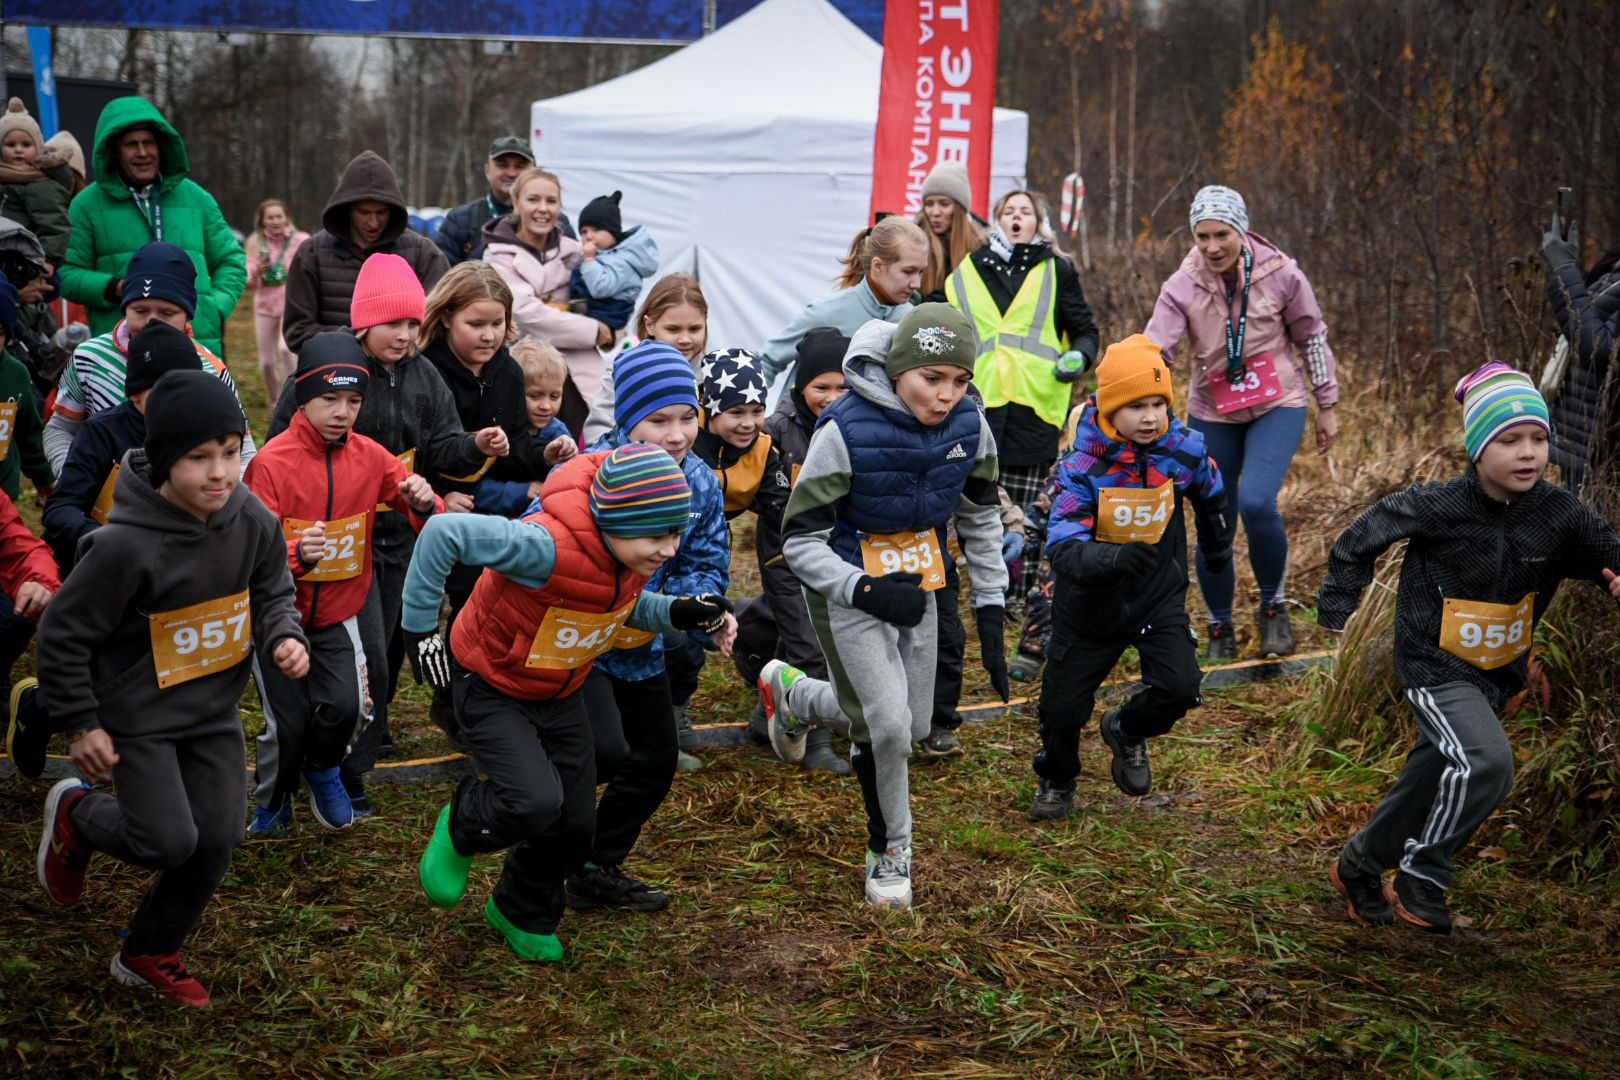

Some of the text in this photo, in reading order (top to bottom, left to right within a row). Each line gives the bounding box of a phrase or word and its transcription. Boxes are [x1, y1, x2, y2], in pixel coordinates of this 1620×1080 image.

[328, 376, 358, 384] GERMES
[1160, 488, 1170, 499] FUN
[1113, 500, 1167, 527] 954
[345, 521, 360, 531] FUN
[915, 530, 931, 540] FUN
[322, 534, 355, 561] 52
[880, 542, 933, 574] 953
[1516, 604, 1529, 617] FUN
[173, 611, 247, 654] 957
[1459, 619, 1525, 649] 958
